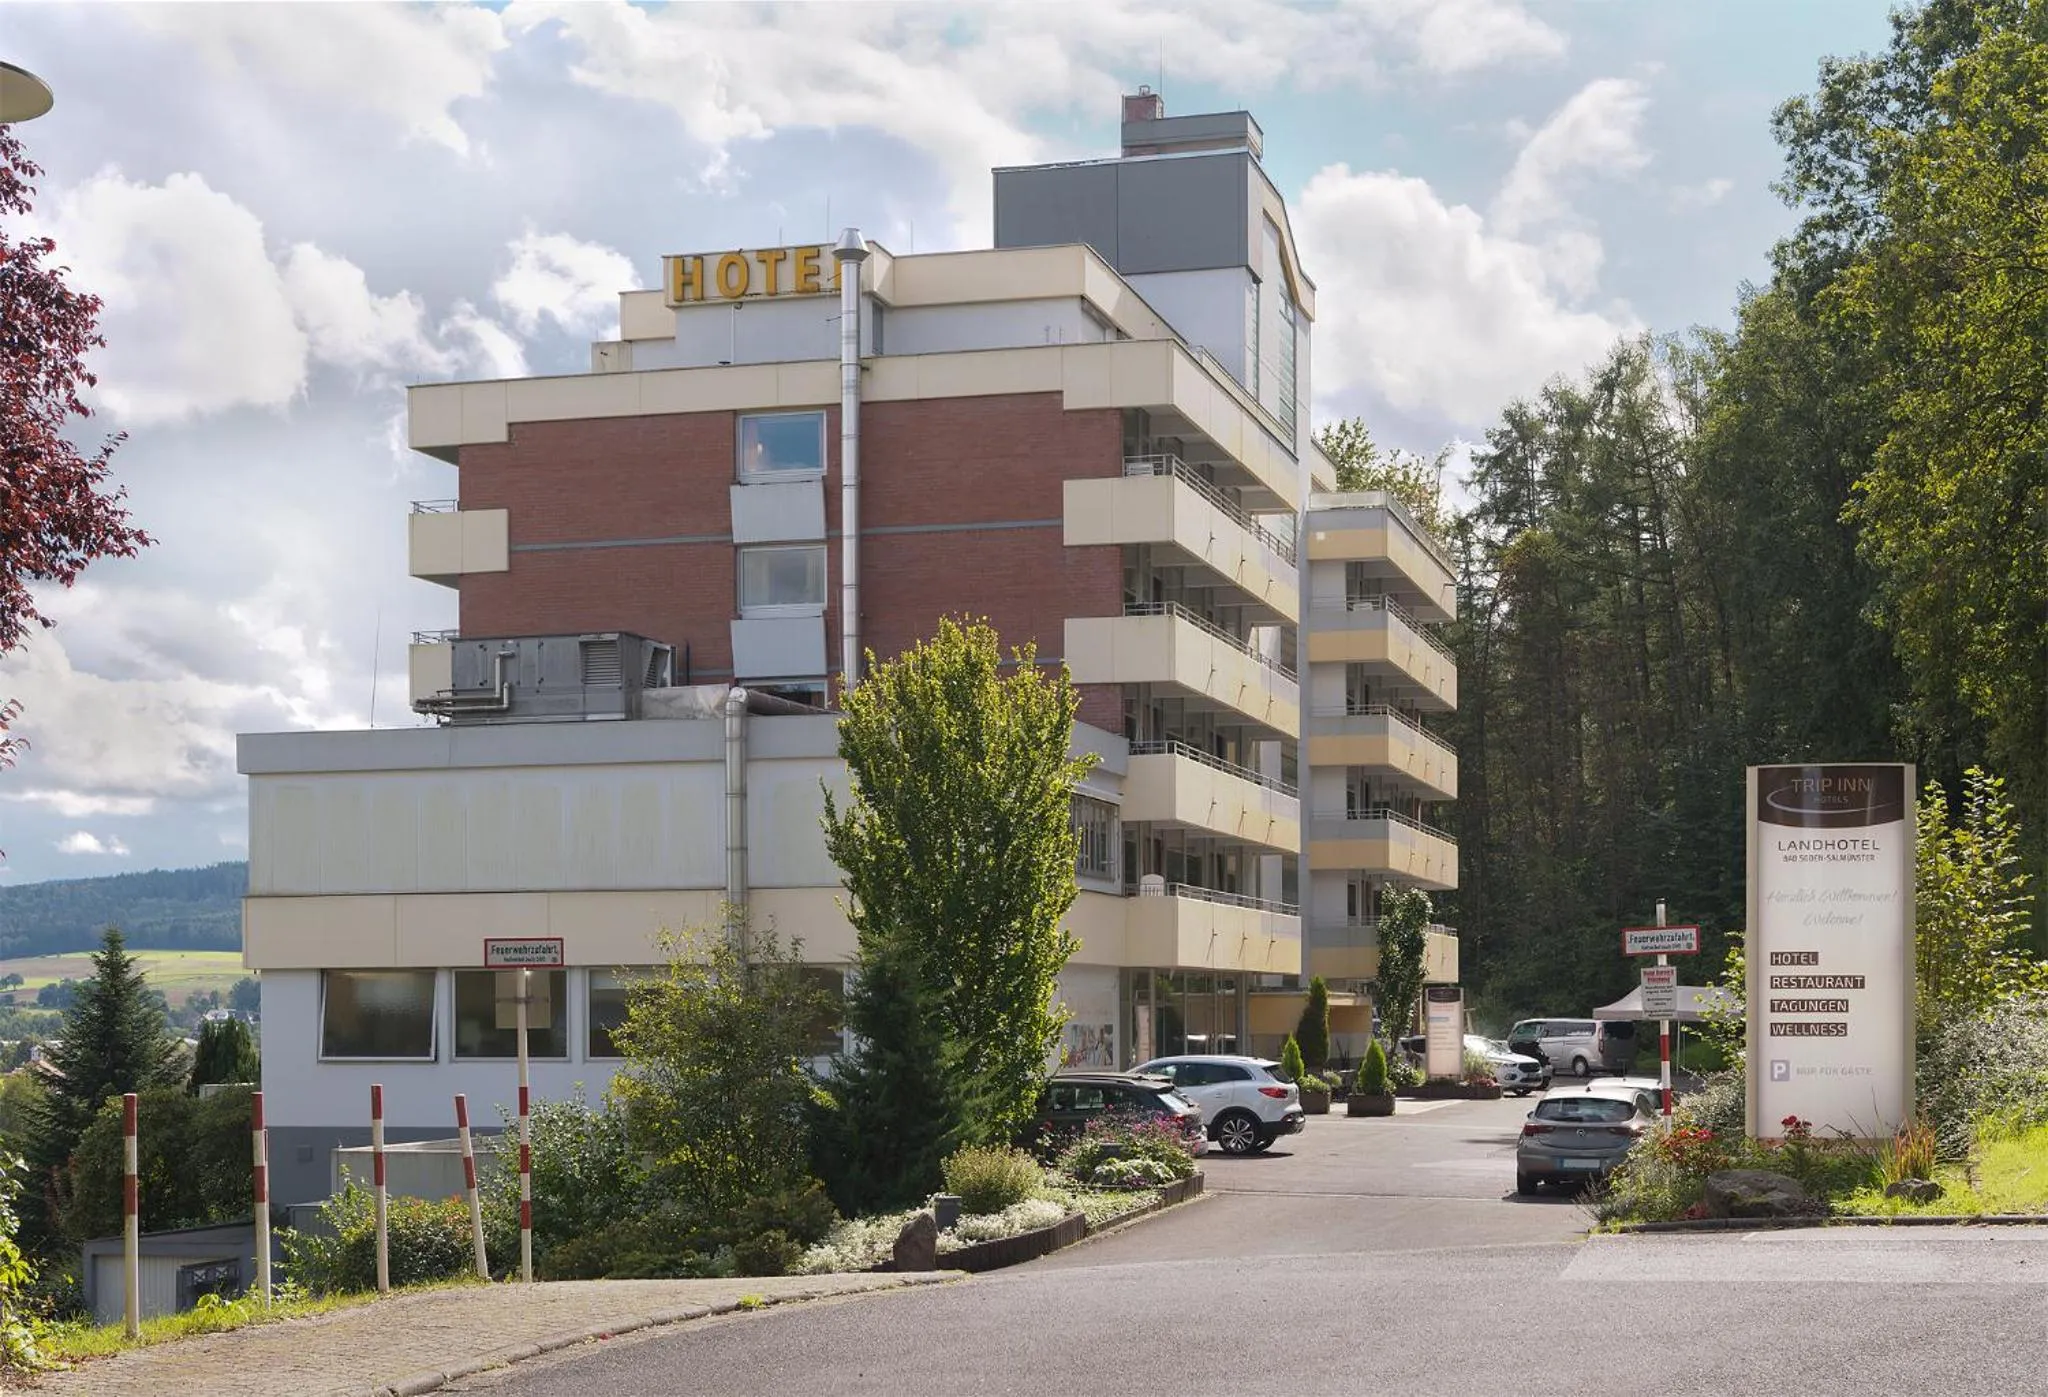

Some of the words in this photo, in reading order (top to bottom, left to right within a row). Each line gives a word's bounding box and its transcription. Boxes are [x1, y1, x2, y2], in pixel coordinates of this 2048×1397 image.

[1792, 778, 1832, 793] TRIP
[1838, 777, 1871, 792] INN
[1778, 839, 1880, 851] LANDHOTEL
[1771, 953, 1817, 965] HOTEL
[1772, 976, 1864, 988] RESTAURANT
[1772, 1000, 1847, 1012] TAGUNGEN
[1772, 1024, 1846, 1036] WELLNESS
